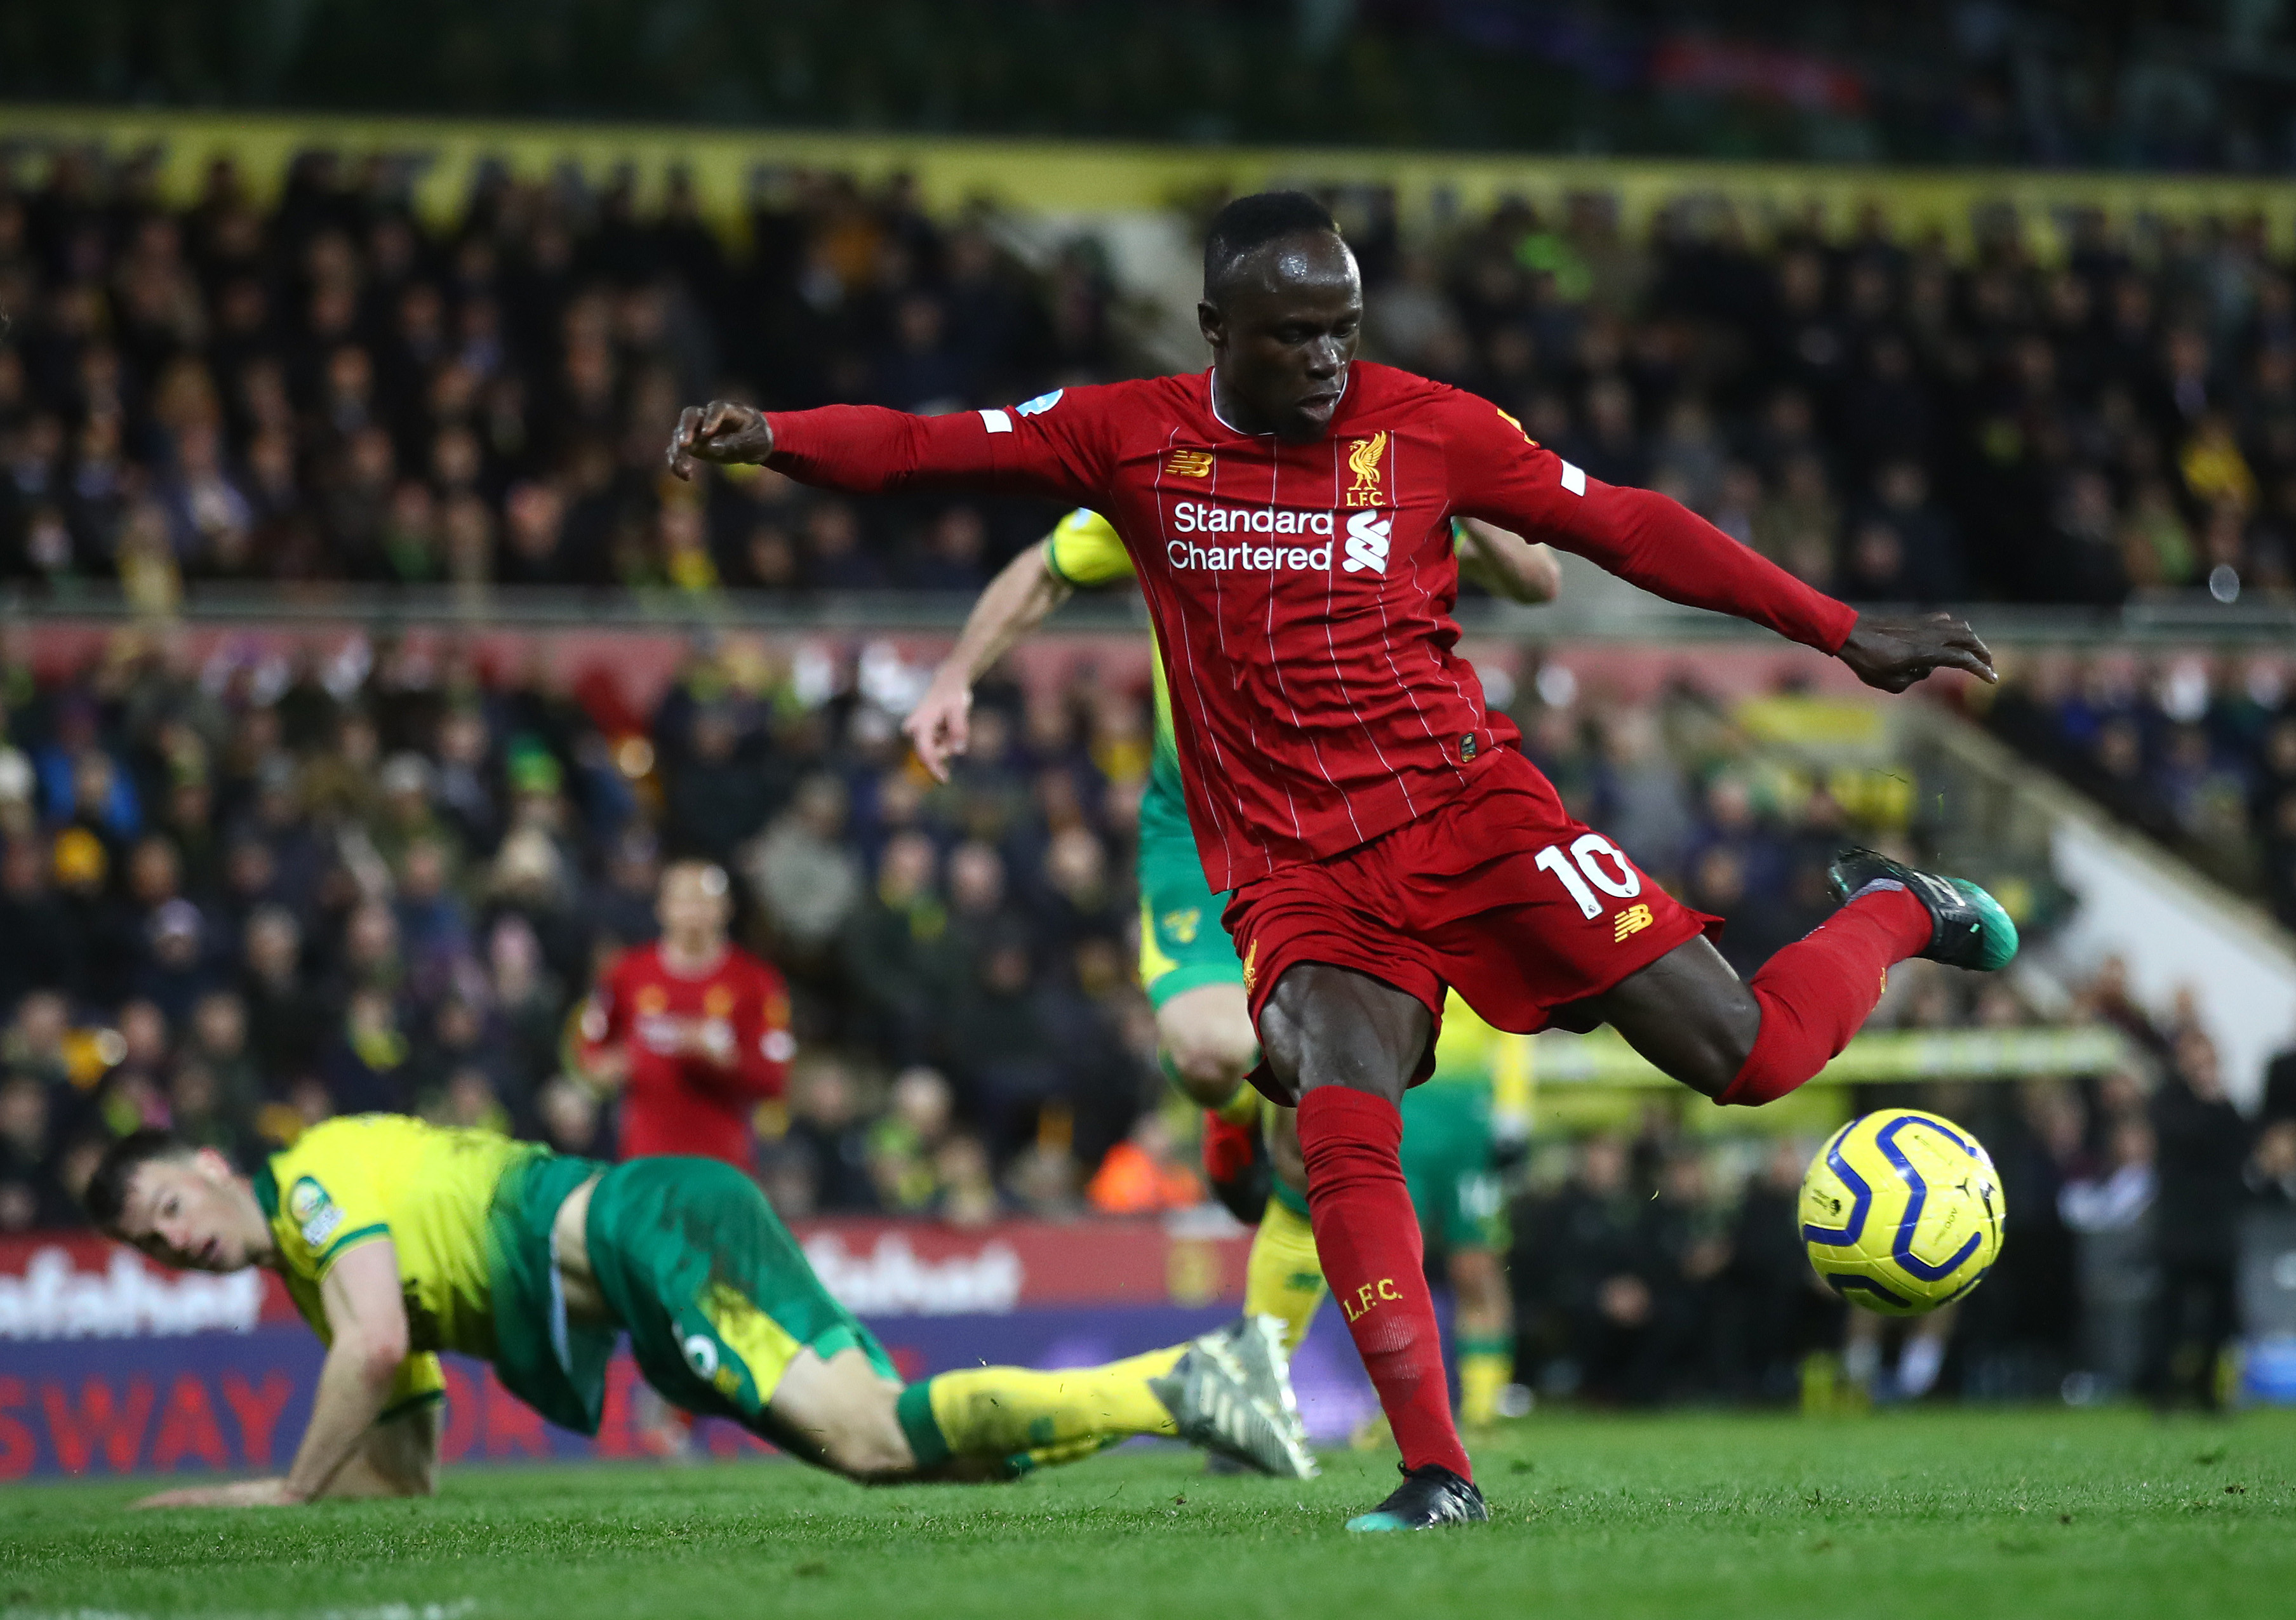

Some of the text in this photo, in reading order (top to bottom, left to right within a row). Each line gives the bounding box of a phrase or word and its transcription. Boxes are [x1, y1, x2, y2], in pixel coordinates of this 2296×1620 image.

[1346, 491, 1386, 507] L.F.C.
[1174, 502, 1333, 534] Standard
[1167, 540, 1332, 571] Chartered
[1535, 833, 1641, 920] 10
[1343, 1278, 1404, 1323] L.F.C.
